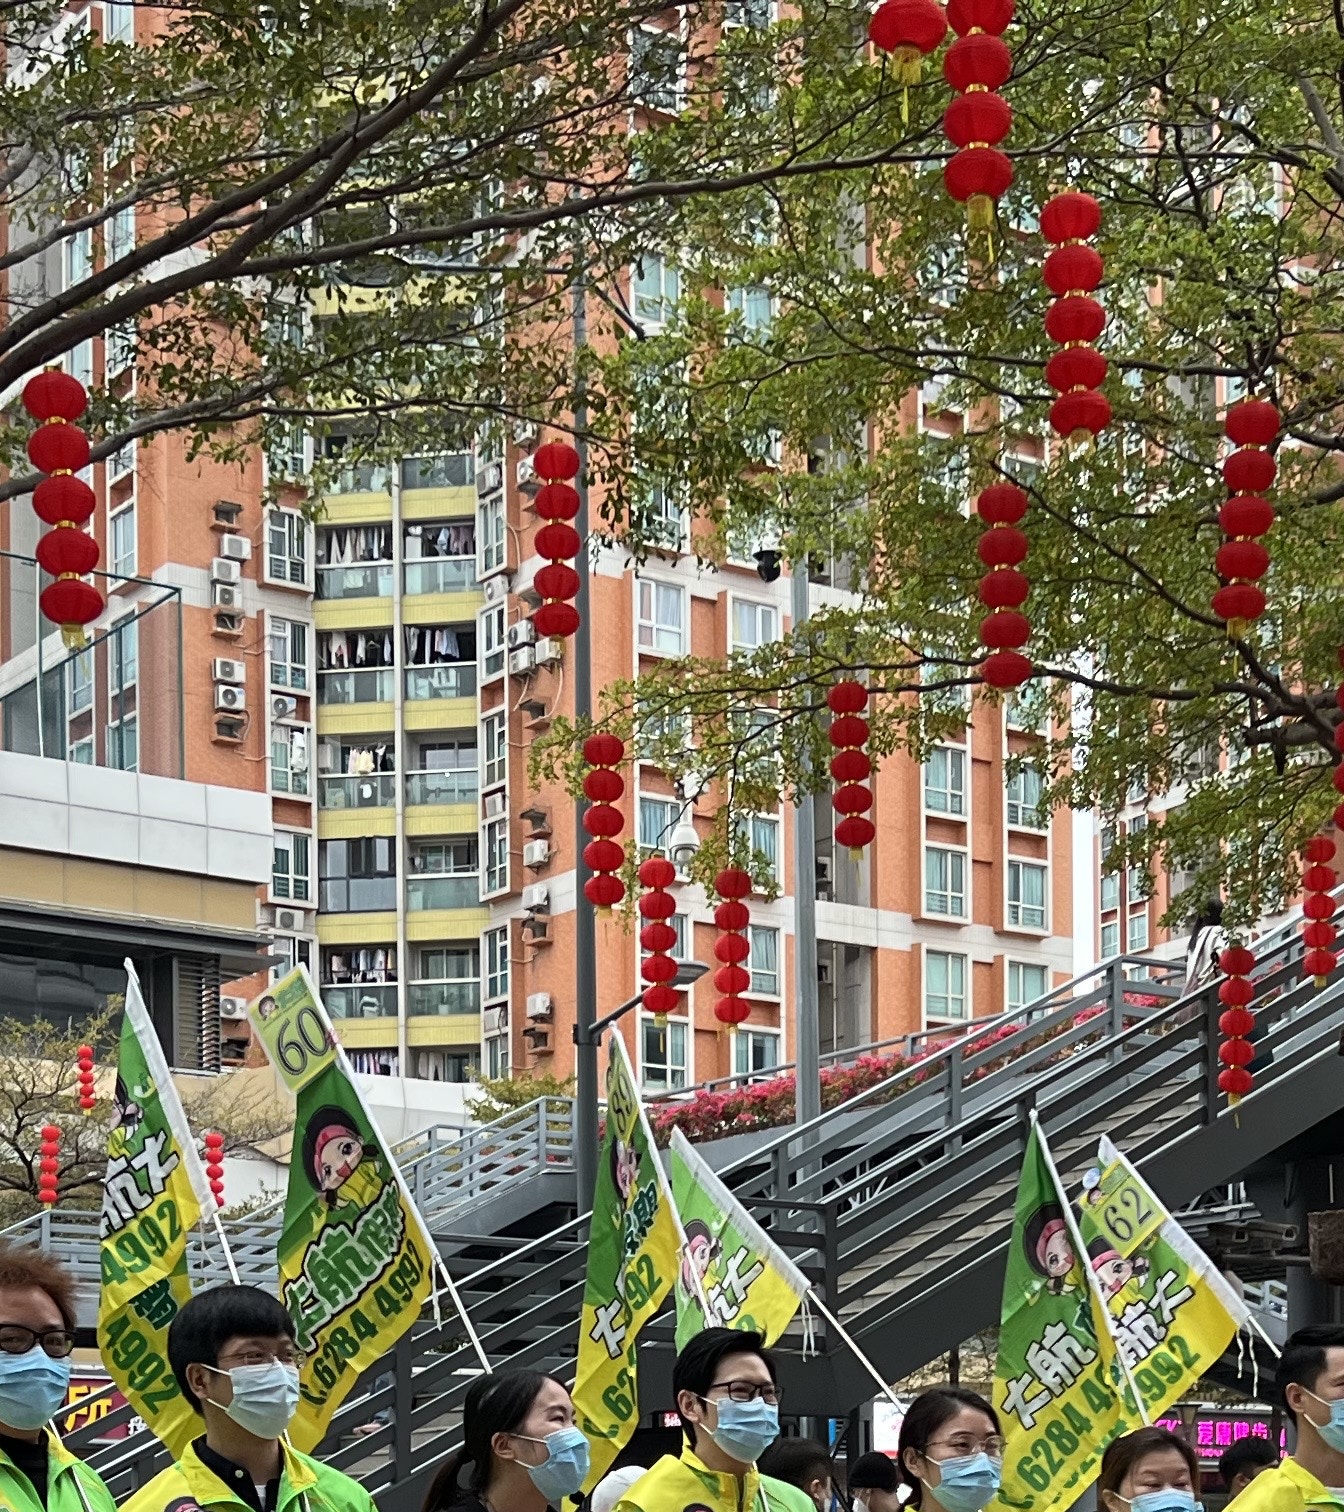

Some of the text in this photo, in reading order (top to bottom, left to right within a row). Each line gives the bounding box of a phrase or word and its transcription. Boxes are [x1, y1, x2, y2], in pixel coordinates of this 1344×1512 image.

[276, 1006, 329, 1076] 60
[1102, 1187, 1155, 1243] 62
[311, 1296, 378, 1384] 6284
[1016, 1388, 1094, 1494] 6284
